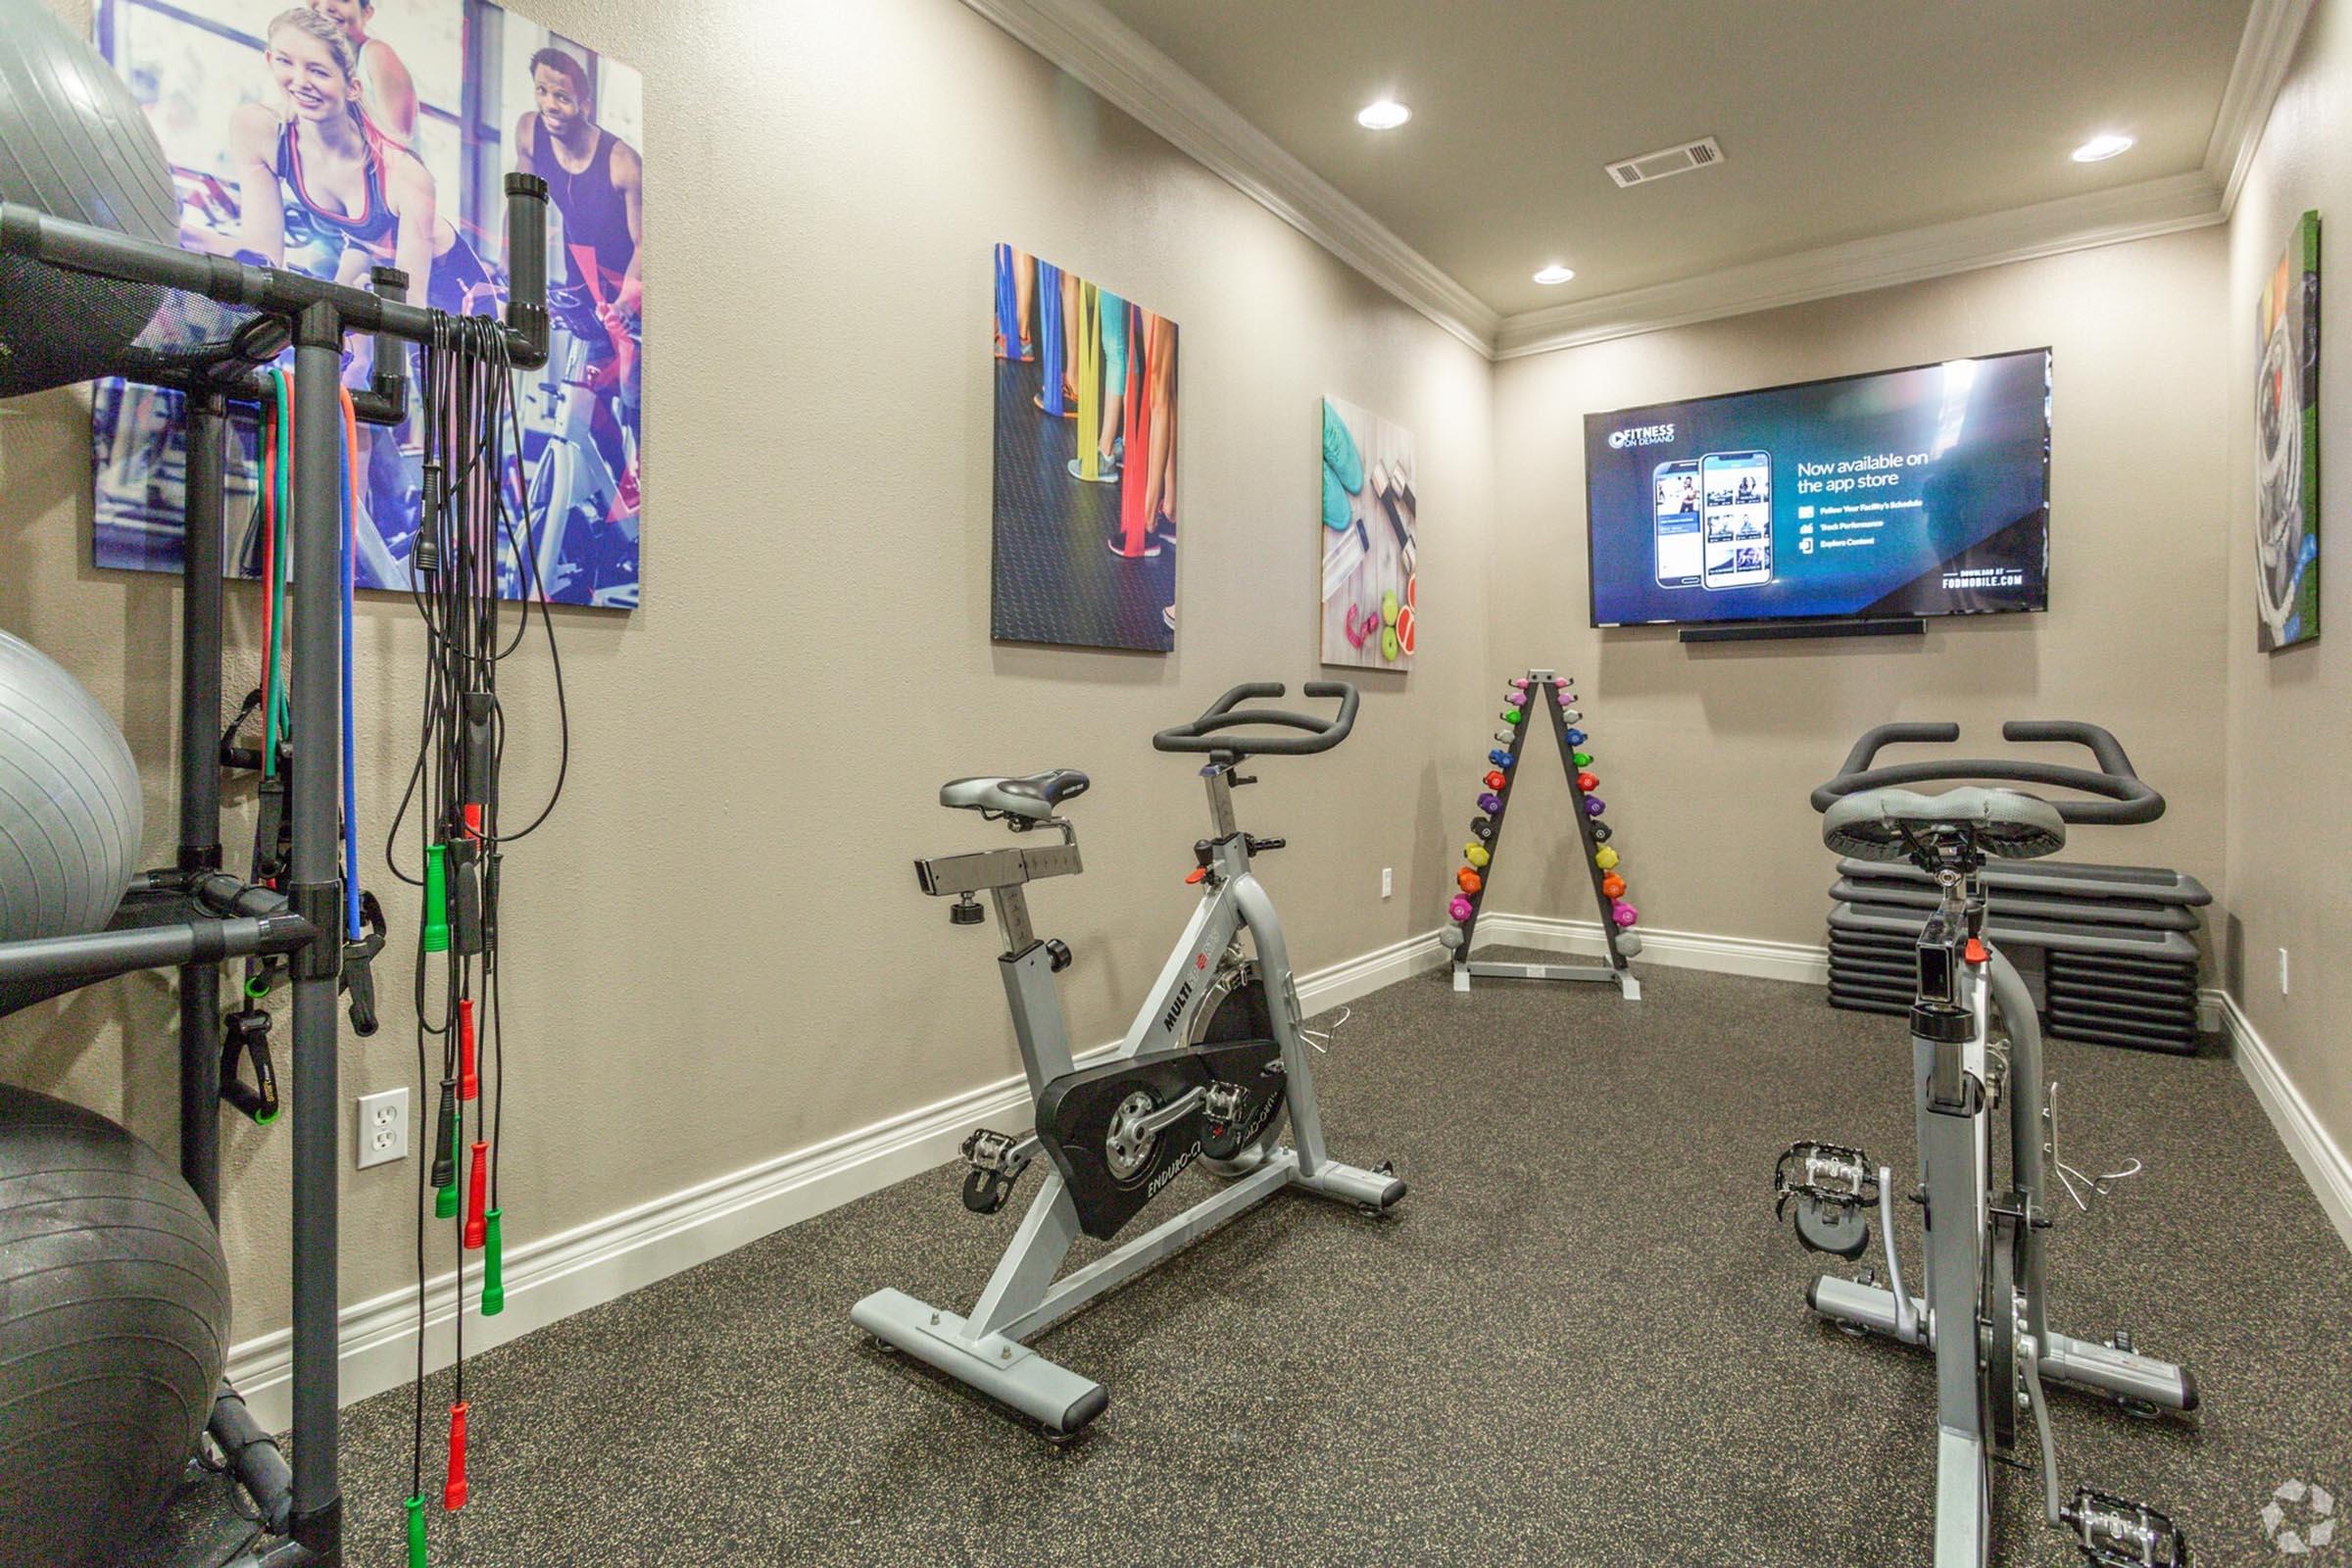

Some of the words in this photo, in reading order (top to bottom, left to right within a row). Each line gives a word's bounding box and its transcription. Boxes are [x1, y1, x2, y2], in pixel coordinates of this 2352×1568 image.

[1624, 423, 1675, 440] FITNESS
[1624, 439, 1637, 448] ON
[1638, 434, 1675, 446] DEMAND
[1797, 463, 1835, 477] Now
[1837, 453, 1903, 473] available
[1906, 453, 1929, 466] on
[1797, 479, 1823, 494] the
[1826, 477, 1855, 493] app
[1857, 473, 1899, 488] store
[1942, 574, 2023, 589] FODMOBILE.COM
